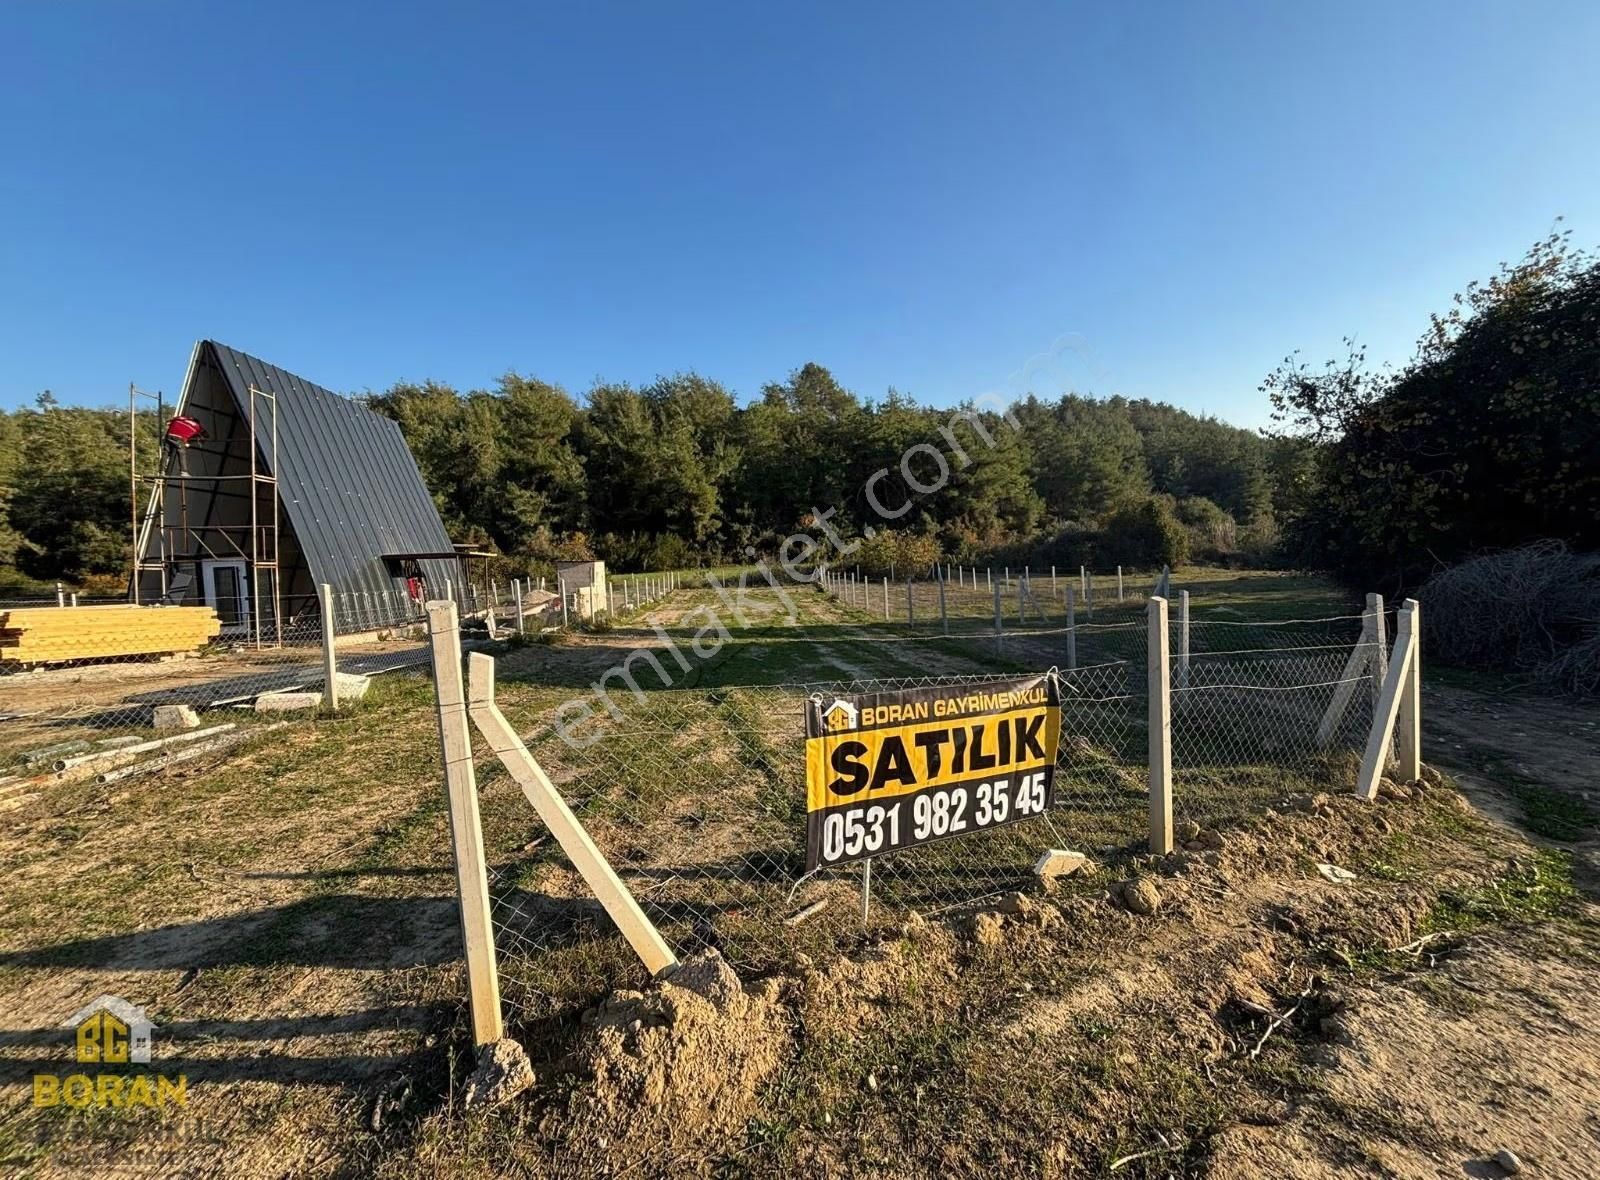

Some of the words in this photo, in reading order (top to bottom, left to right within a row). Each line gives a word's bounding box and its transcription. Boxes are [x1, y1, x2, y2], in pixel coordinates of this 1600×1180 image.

[861, 701, 929, 726] BORAN
[933, 687, 1049, 717] GAYRİMENKUL
[828, 714, 1047, 797] SATILIK
[823, 802, 902, 862] 0531
[913, 787, 968, 841] 982
[975, 779, 1009, 826] 35
[1014, 772, 1046, 815] 45
